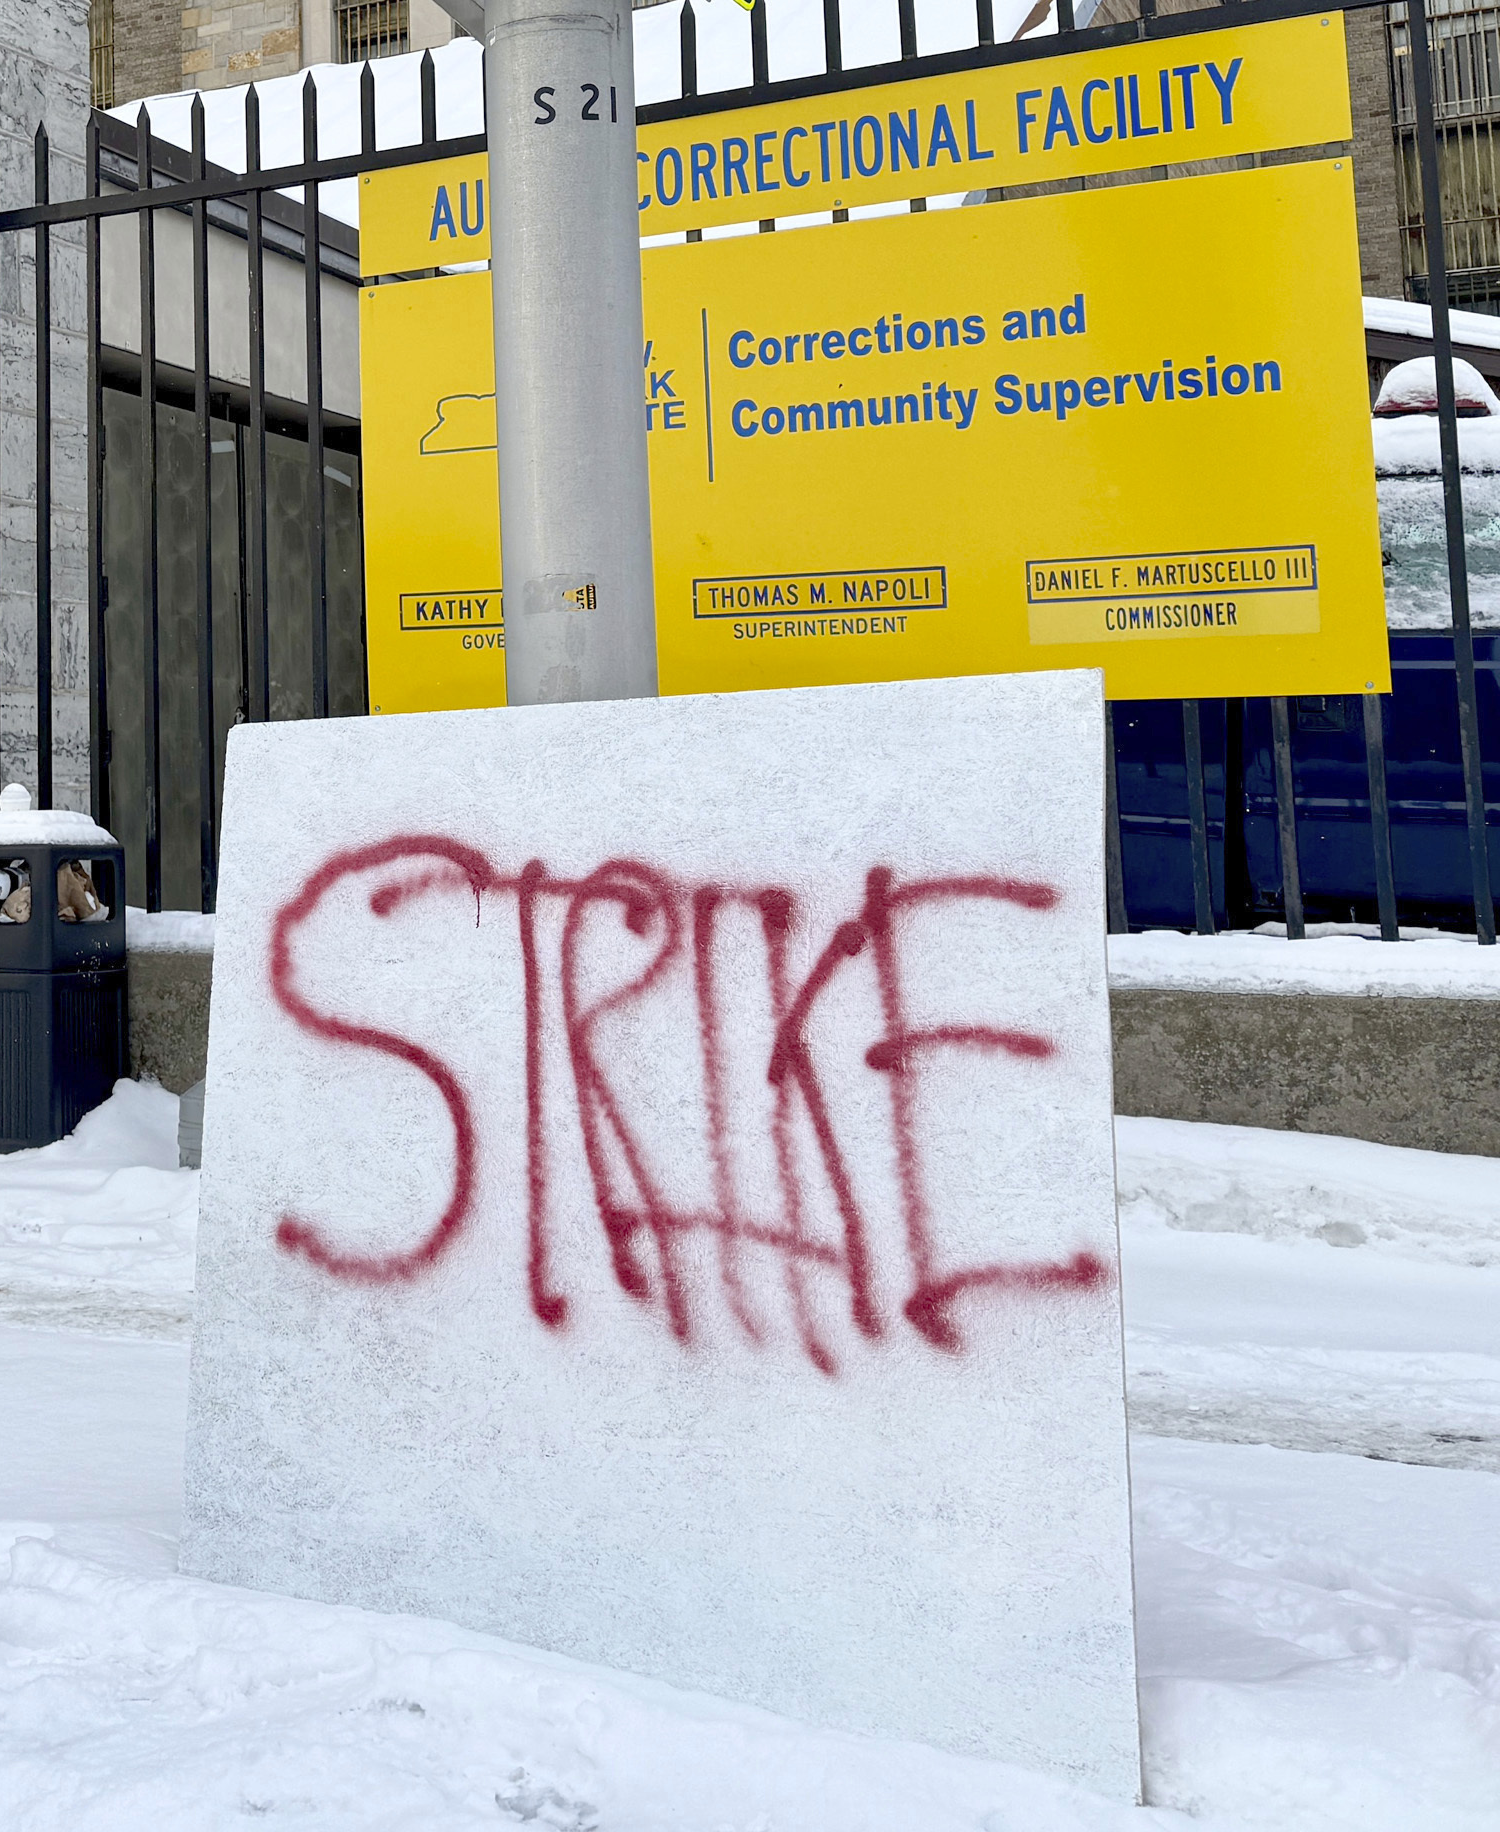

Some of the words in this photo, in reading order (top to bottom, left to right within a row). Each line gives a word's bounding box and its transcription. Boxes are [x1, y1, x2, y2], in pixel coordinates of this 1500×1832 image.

[534, 86, 557, 125] S
[581, 83, 618, 124] 21
[1016, 57, 1244, 155] FACILITY
[728, 311, 986, 369] Corrections
[1003, 293, 1088, 340] and
[732, 380, 979, 439] Community
[994, 354, 1283, 421] Supervision
[708, 583, 799, 609] THOMAS
[810, 581, 833, 605] M.
[844, 577, 930, 603] NAPOLI
[1035, 568, 1104, 592] DANIEL
[1112, 567, 1128, 588] F.
[1137, 558, 1277, 587] MARTUSCELLO
[1286, 557, 1308, 580] III
[416, 598, 489, 621] KATHY
[733, 616, 908, 639] SUPERINTENDENT
[1105, 602, 1238, 631] COMMISSIONER
[270, 834, 1111, 1378] STRIKE
